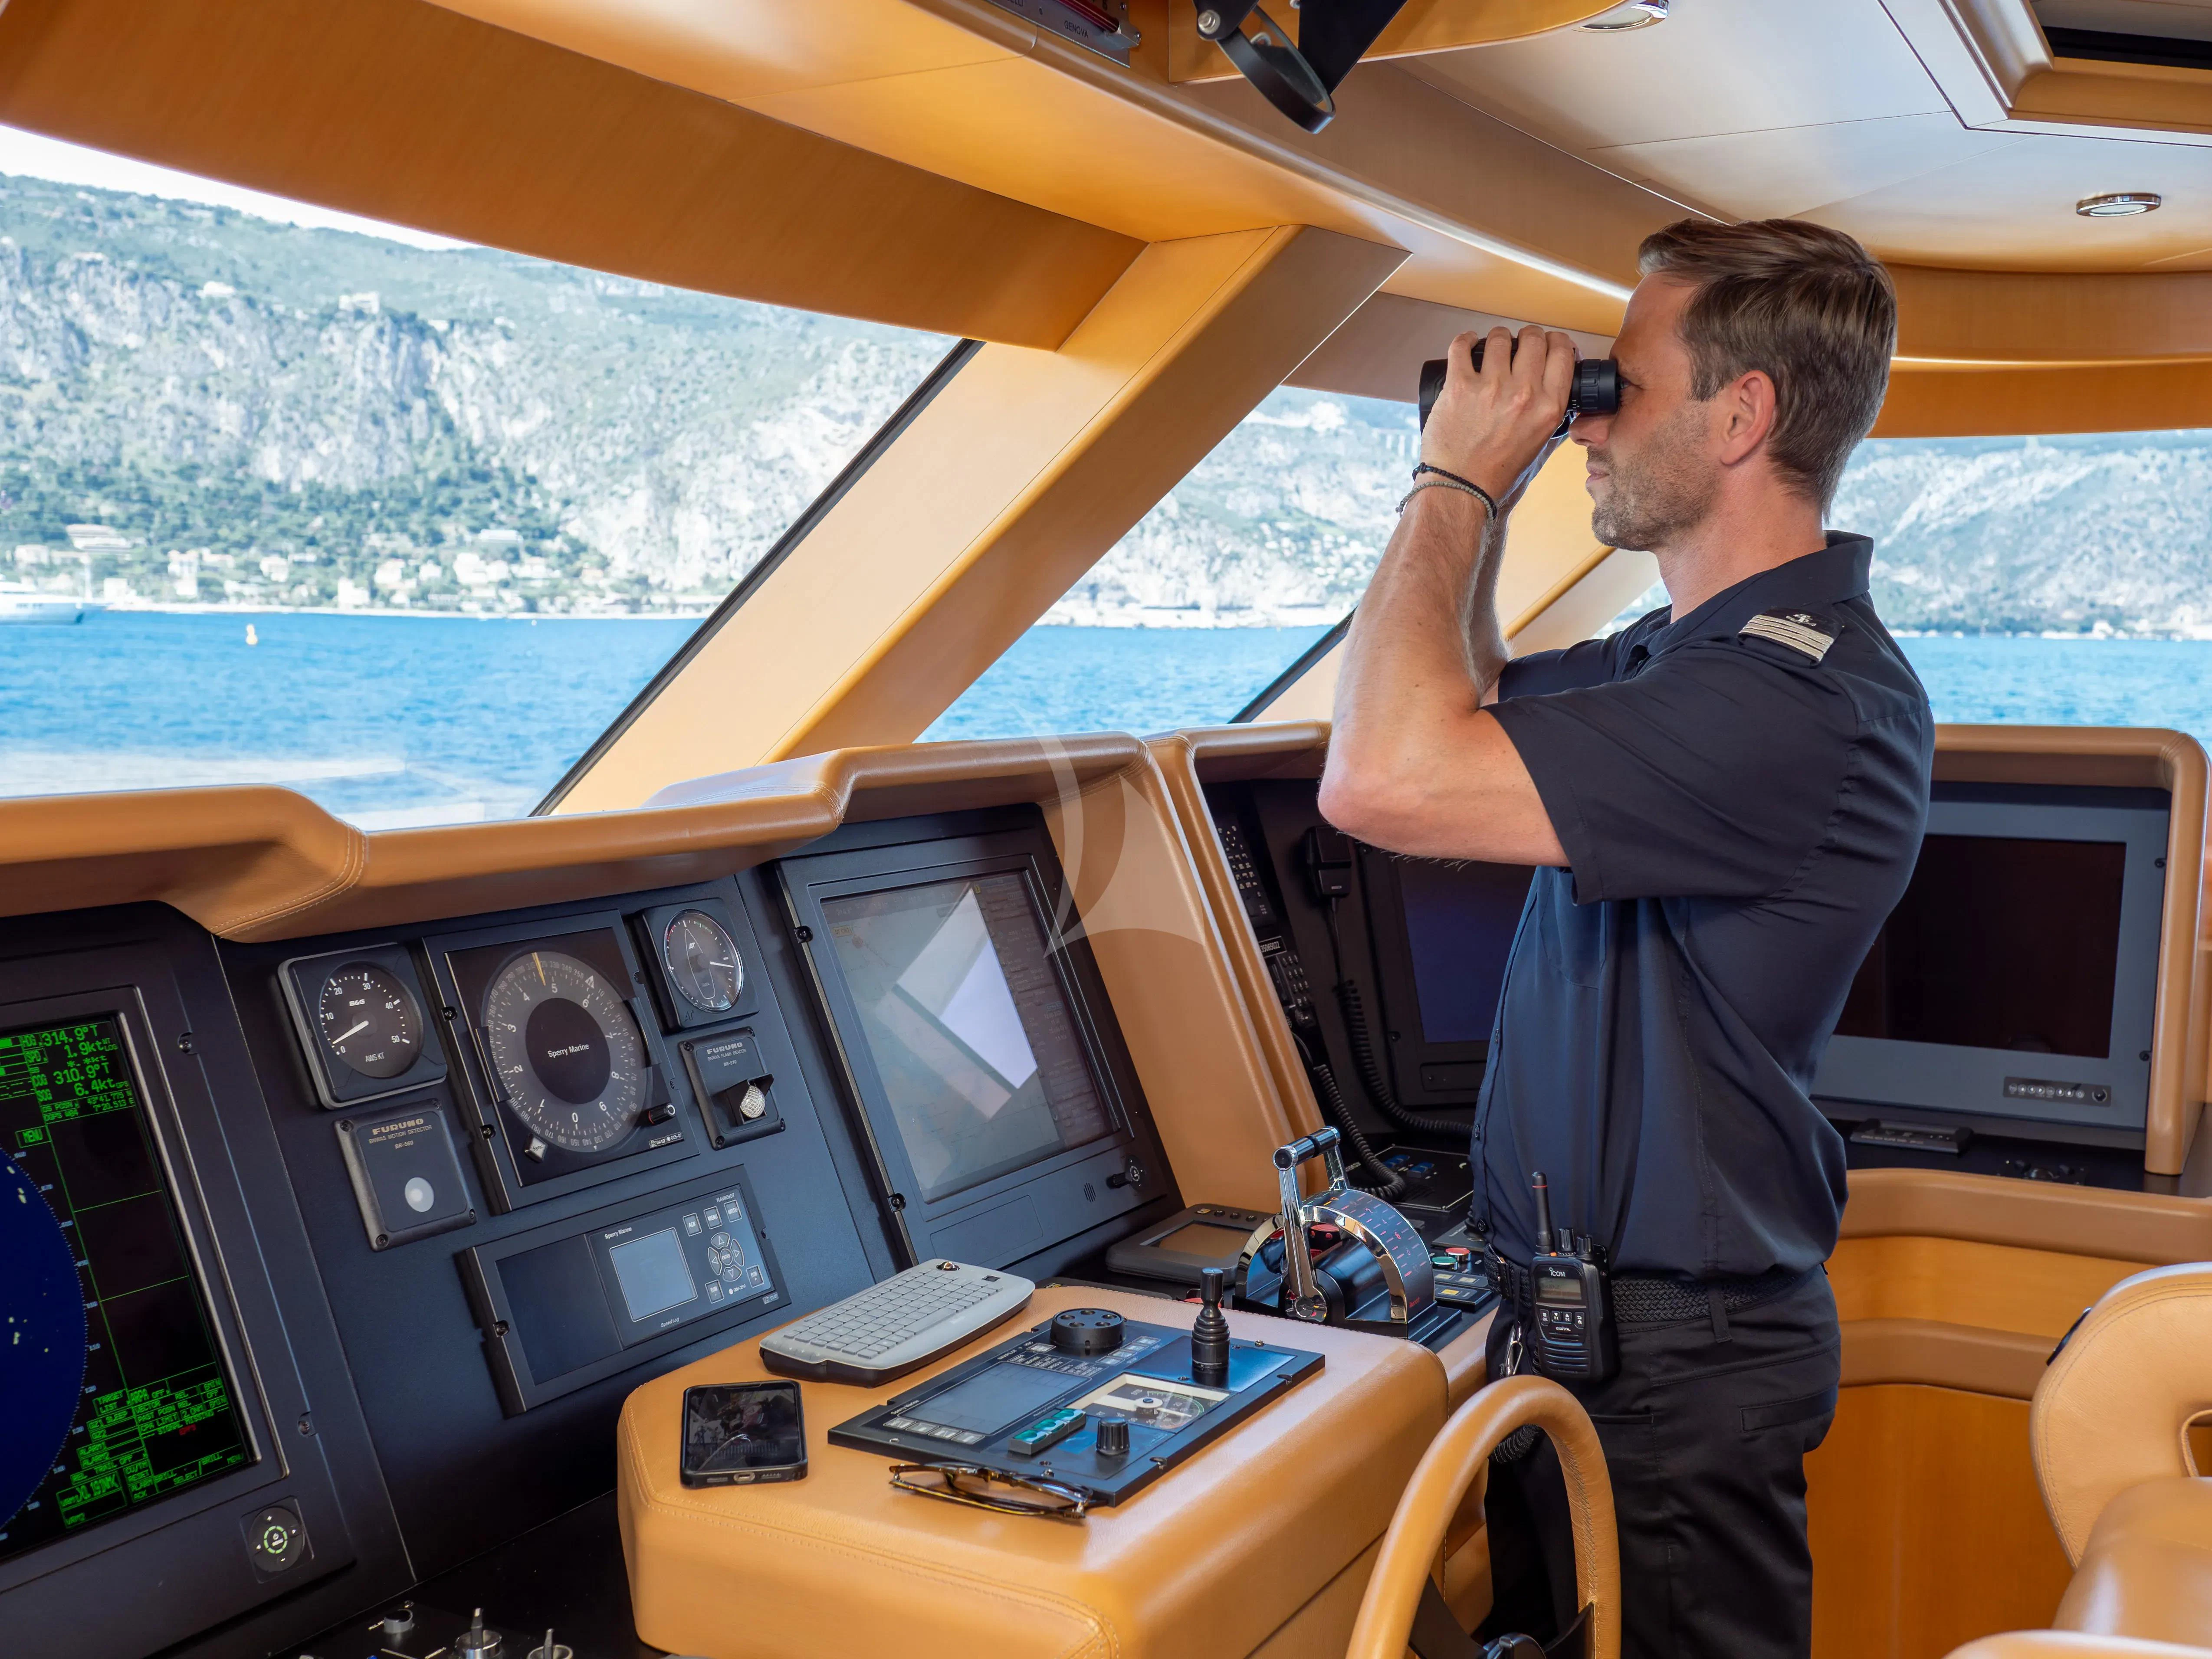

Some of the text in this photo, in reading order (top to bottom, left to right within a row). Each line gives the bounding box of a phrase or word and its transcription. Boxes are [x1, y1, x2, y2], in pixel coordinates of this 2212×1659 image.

[1064, 20, 1088, 38] GENOVA
[551, 983, 558, 993] 5
[523, 992, 530, 1001] 4
[582, 999, 589, 1007] 6
[507, 1023, 517, 1033] 3
[548, 1043, 590, 1058] Sperry Marine
[707, 1042, 743, 1055] FURUNO
[513, 1064, 523, 1073] 2
[611, 1071, 619, 1079] 8
[572, 1112, 578, 1123] 0
[372, 1118, 423, 1135] FURUNO
[388, 1131, 406, 1139] MOTION
[407, 1125, 432, 1135] DETECTOR
[604, 1231, 618, 1239] Sperry
